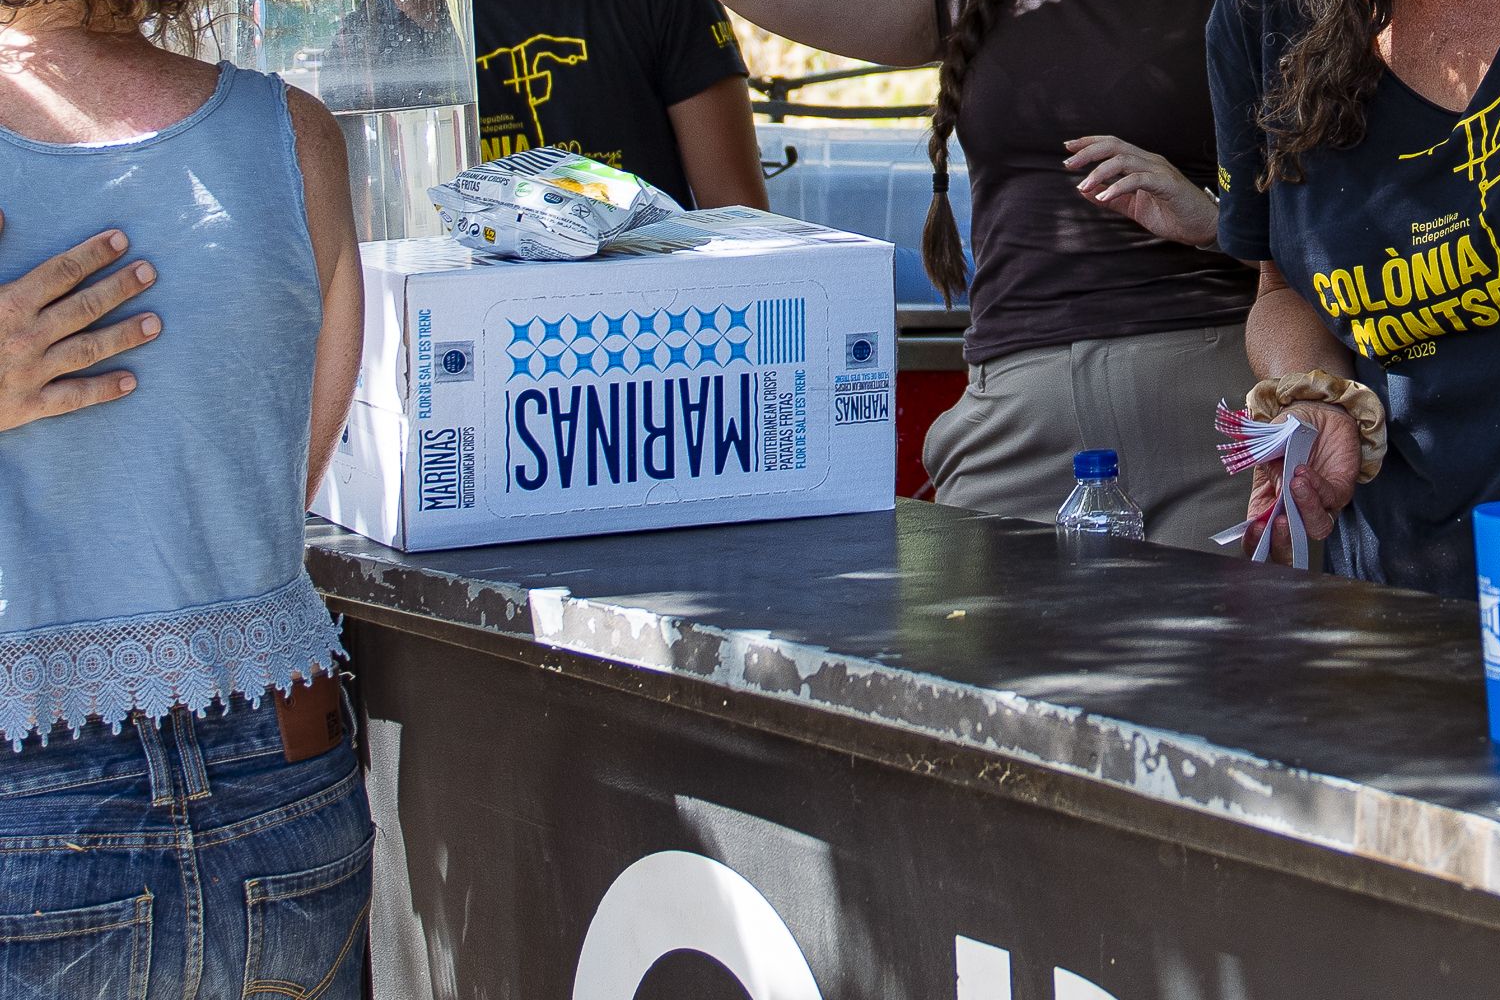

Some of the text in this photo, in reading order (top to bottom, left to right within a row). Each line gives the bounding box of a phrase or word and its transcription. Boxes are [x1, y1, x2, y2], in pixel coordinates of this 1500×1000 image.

[462, 179, 481, 192] FRITAS
[1313, 235, 1492, 317] COLÒNIA
[418, 309, 432, 420] FLOR DE SAL D'ES TRENC
[835, 375, 850, 384] TRENC
[835, 380, 889, 393] MEDITERRANEAN CRISPS
[861, 373, 871, 381] SAL
[870, 373, 877, 381] DE
[1404, 341, 1437, 360] 2026
[516, 374, 751, 492] MARINAS
[764, 371, 778, 472] MEDITERRANEAN CRISPS
[779, 393, 794, 471] PATATAS FRITAS
[795, 370, 807, 469] FLOR DE SAL D'ES TRENC
[835, 394, 889, 422] MARINAS
[424, 428, 457, 511] MARINAS
[463, 426, 476, 509] MEDITERRANEAN CRISPS
